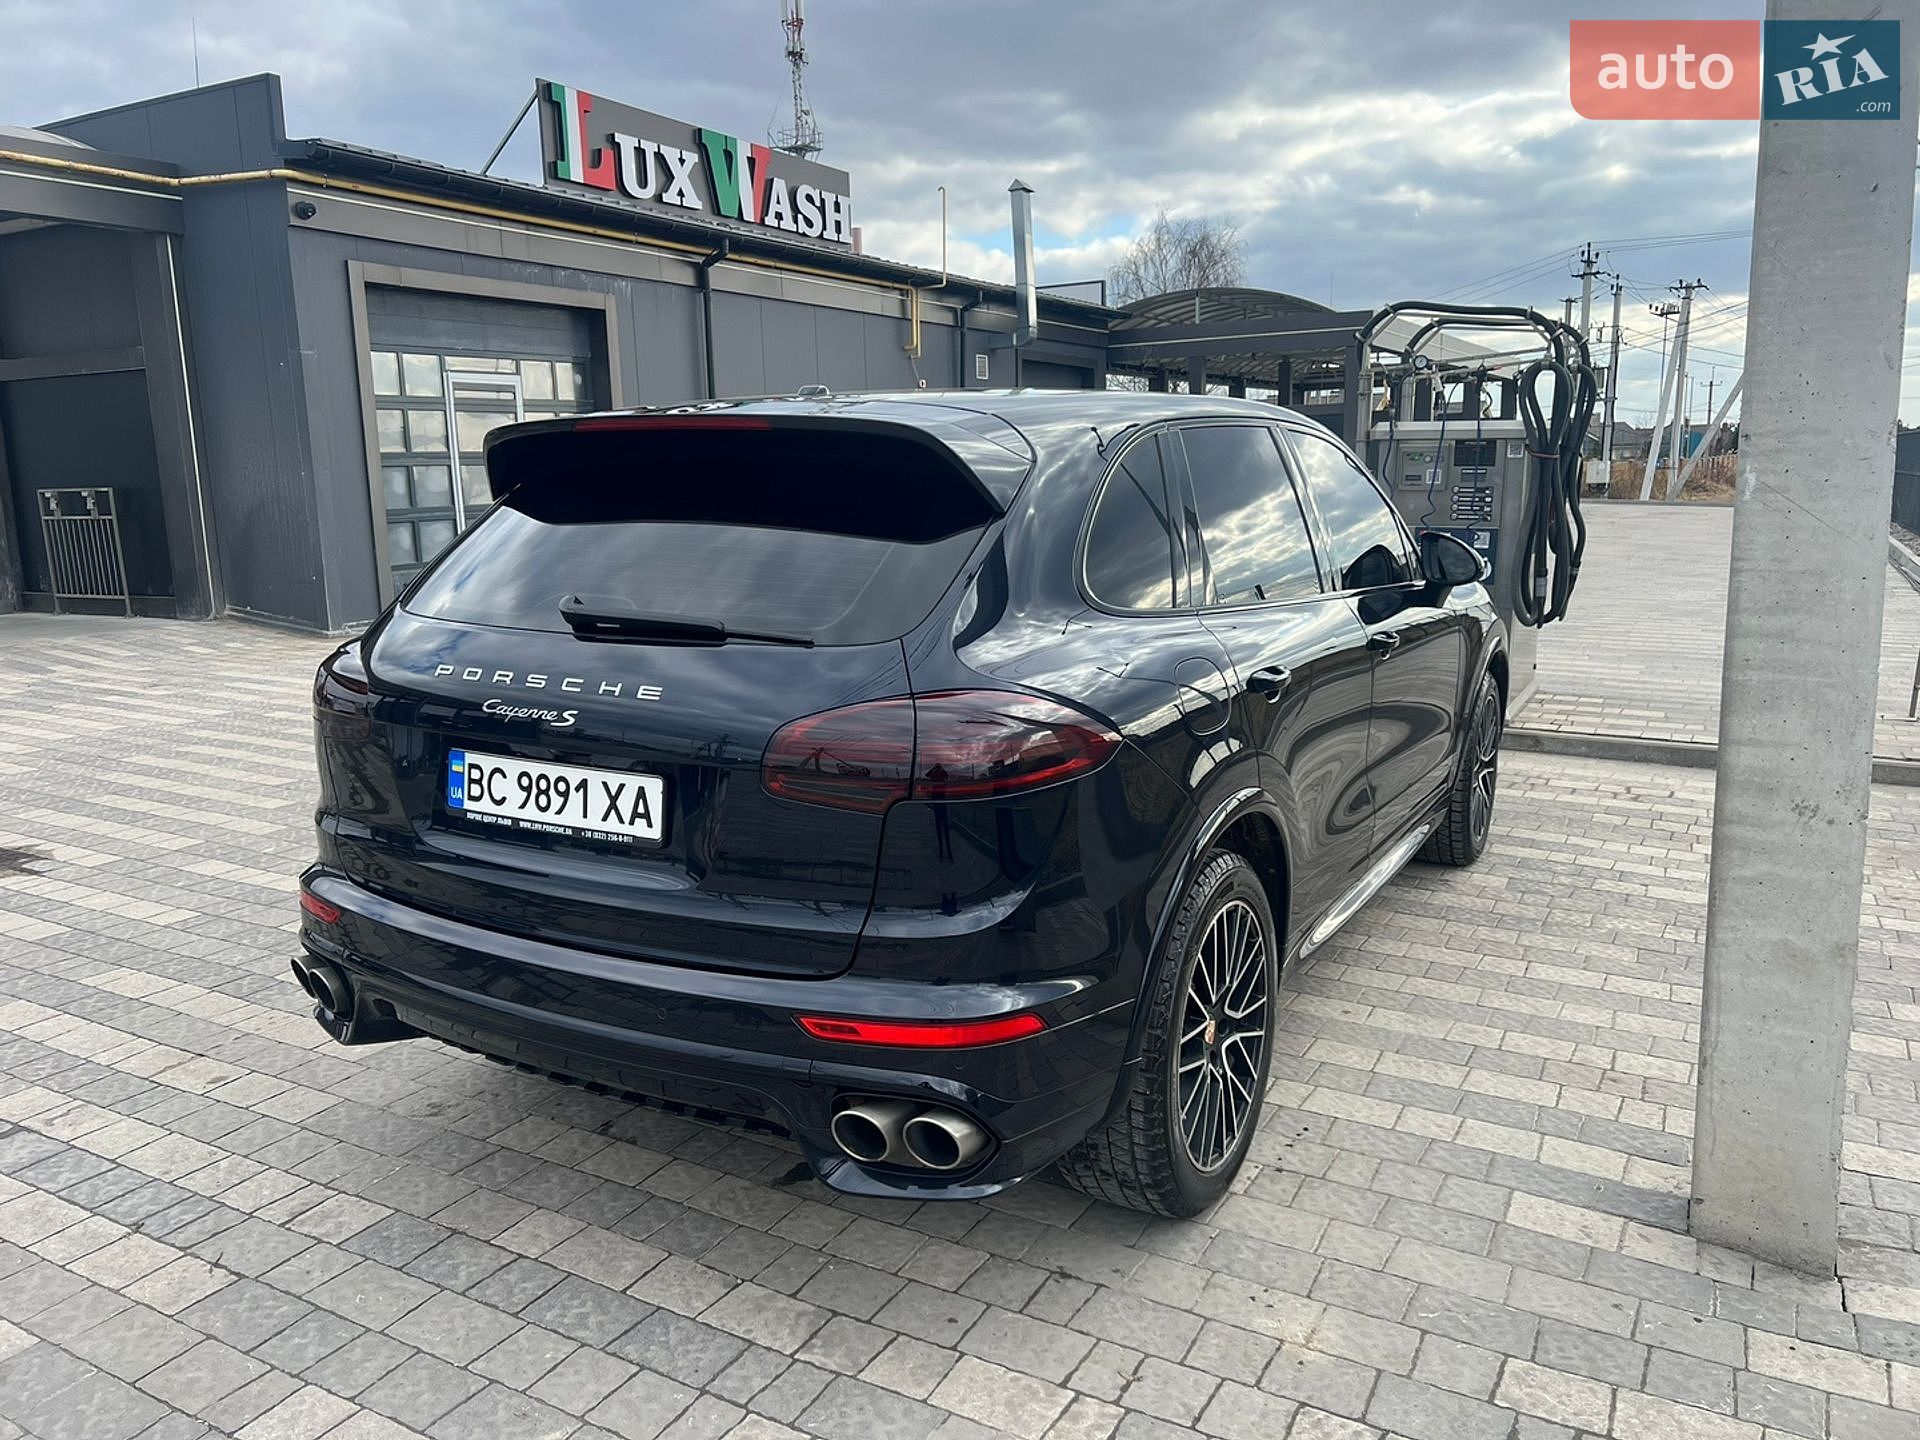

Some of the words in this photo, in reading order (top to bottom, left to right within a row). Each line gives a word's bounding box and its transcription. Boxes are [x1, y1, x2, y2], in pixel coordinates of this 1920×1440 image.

[434, 664, 664, 700] PORSCHE
[481, 698, 558, 724] Cayenne
[550, 709, 579, 727] S
[450, 786, 463, 800] UA
[466, 762, 508, 807] BC
[516, 770, 589, 820] 9891
[601, 780, 653, 829] XA
